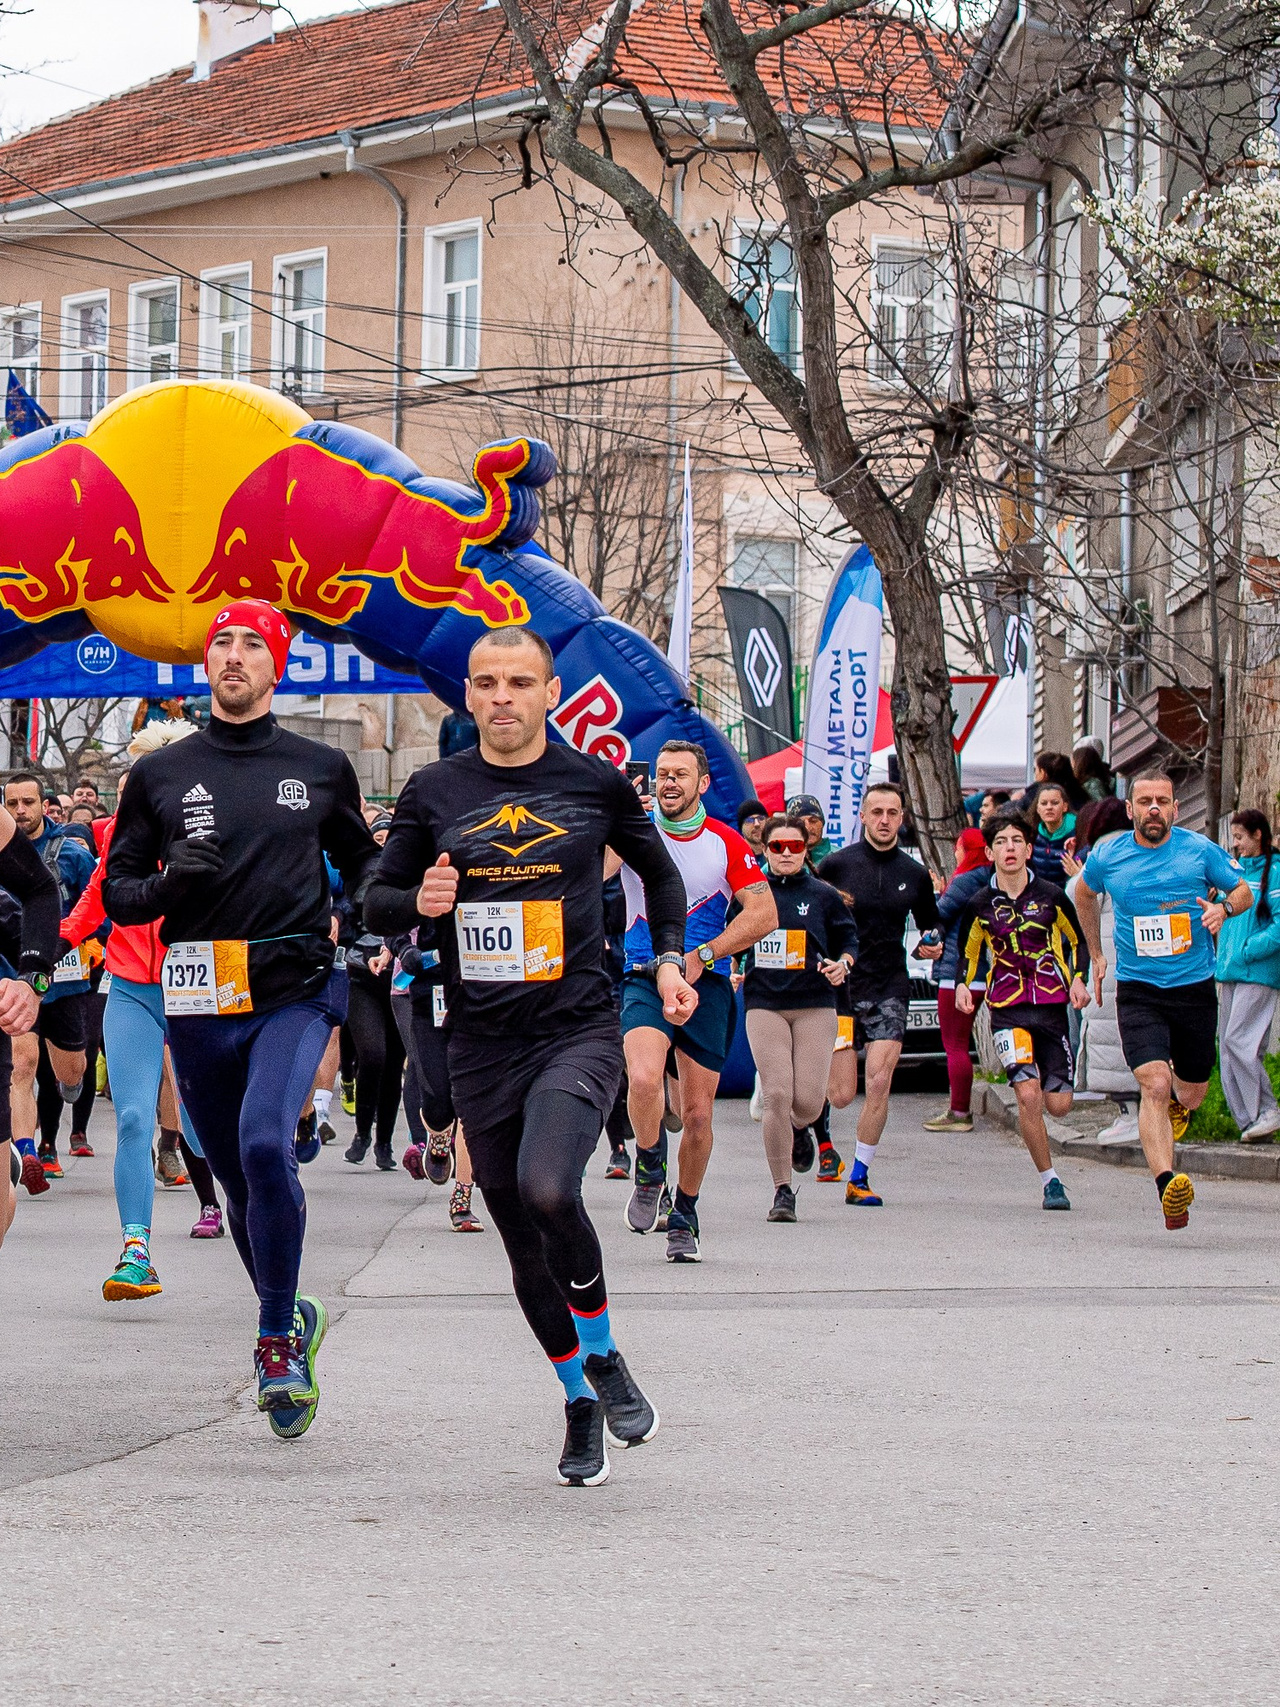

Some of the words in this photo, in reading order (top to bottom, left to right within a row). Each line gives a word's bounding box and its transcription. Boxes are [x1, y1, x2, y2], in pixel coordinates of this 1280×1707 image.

[84, 646, 110, 659] P/H
[848, 649, 868, 739] СПОРТ
[552, 679, 629, 774] Re
[181, 794, 213, 803] adidas
[466, 867, 502, 877] ASICS
[503, 864, 563, 876] FUJITRAIL
[487, 906, 501, 916] 12K
[462, 926, 513, 952] 1160
[1140, 927, 1164, 941] 1113
[759, 940, 782, 954] 1317
[503, 953, 518, 961] TRAIL
[167, 963, 209, 988] 1372
